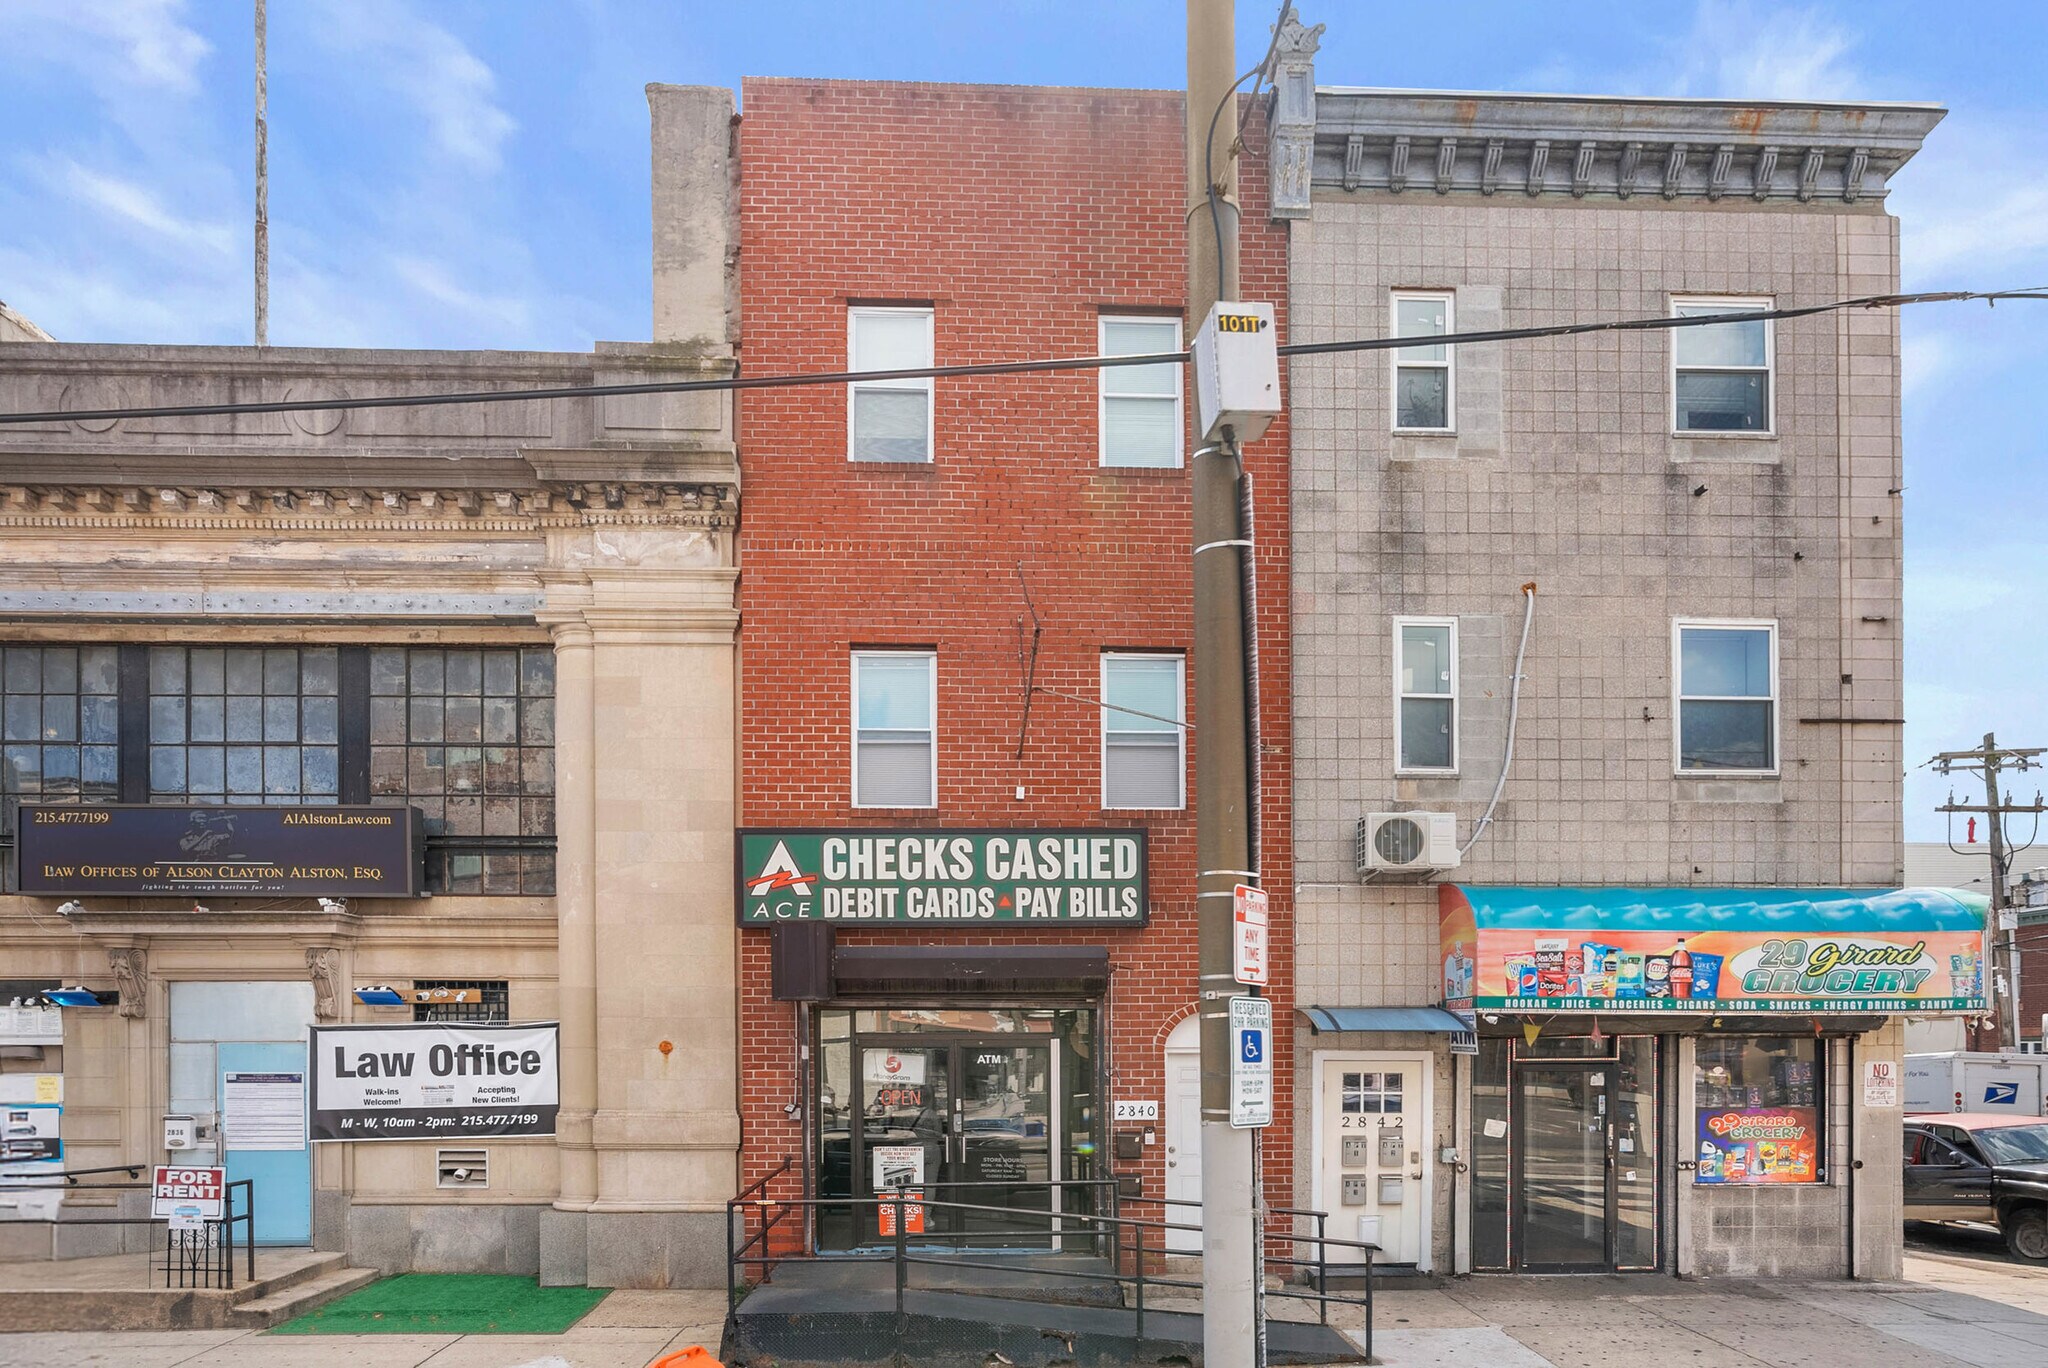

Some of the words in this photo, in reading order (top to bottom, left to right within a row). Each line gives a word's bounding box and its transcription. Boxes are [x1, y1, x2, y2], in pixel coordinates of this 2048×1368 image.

[1220, 316, 1259, 332] 101T
[35, 812, 109, 823] 215.477.7199
[283, 813, 391, 825] AlAlstonLaw.com
[822, 837, 974, 881] CHECKS
[985, 837, 1138, 881] CASHED
[44, 865, 75, 877] LAW
[81, 865, 137, 877] OFFICES
[142, 866, 160, 877] OF
[166, 865, 213, 878] ALSON
[218, 865, 284, 878] CLAYTON
[290, 866, 348, 880] ALSTON,
[353, 866, 384, 880] ESQ.
[141, 883, 174, 891] fighting
[823, 886, 899, 918] DEBIT
[906, 886, 995, 918] CARDS
[1015, 886, 1064, 918] PAY
[1070, 886, 1138, 918] BILLS
[753, 902, 811, 918] ACE
[1245, 928, 1259, 944] ANY
[1244, 946, 1260, 962] TIME
[1759, 940, 1808, 968] 29
[1807, 941, 1926, 977] Girard
[1540, 982, 1565, 990] Doritos
[1741, 969, 1930, 994] GROCERY
[1234, 1002, 1267, 1015] RESERVED
[1504, 999, 1548, 1008] HOOKAH
[1560, 999, 1591, 1009] JUICE
[1604, 1000, 1663, 1009] GROCERIES
[1676, 1000, 1716, 1010] CIGARS
[1729, 1000, 1757, 1010] SODA
[1770, 1000, 1811, 1010] SNACKS
[1824, 1000, 1863, 1010] ENERGY
[1867, 1000, 1907, 1010] DRINKS
[1920, 1000, 1954, 1009] CANDY
[1233, 1016, 1244, 1028] 2HR
[1247, 1017, 1268, 1029] PARKING
[334, 1046, 415, 1078] Law
[428, 1044, 541, 1077] Office
[977, 1054, 1001, 1064] ATM
[1873, 1063, 1889, 1077] NO
[873, 1073, 911, 1081] MoneyGram
[365, 1088, 400, 1096] Walk-ins
[477, 1086, 516, 1095] Accepting
[363, 1098, 402, 1106] Welcome!
[472, 1096, 489, 1104] New
[491, 1095, 520, 1104] Clients!
[881, 1090, 921, 1106] OPEN
[1118, 1105, 1156, 1117] 2840
[341, 1119, 354, 1128] M
[363, 1118, 379, 1130] W,
[382, 1117, 415, 1128] 10am
[426, 1117, 456, 1129] 2pm:
[461, 1113, 539, 1126] 215.477.7199
[1341, 1116, 1403, 1128] 2842
[1708, 1113, 1741, 1135] 29
[1740, 1116, 1797, 1127] GIRARD
[1730, 1126, 1805, 1139] GROCERY
[166, 1171, 213, 1184] FOR
[158, 1185, 220, 1198] RENT
[880, 1207, 922, 1215] CHKS!
